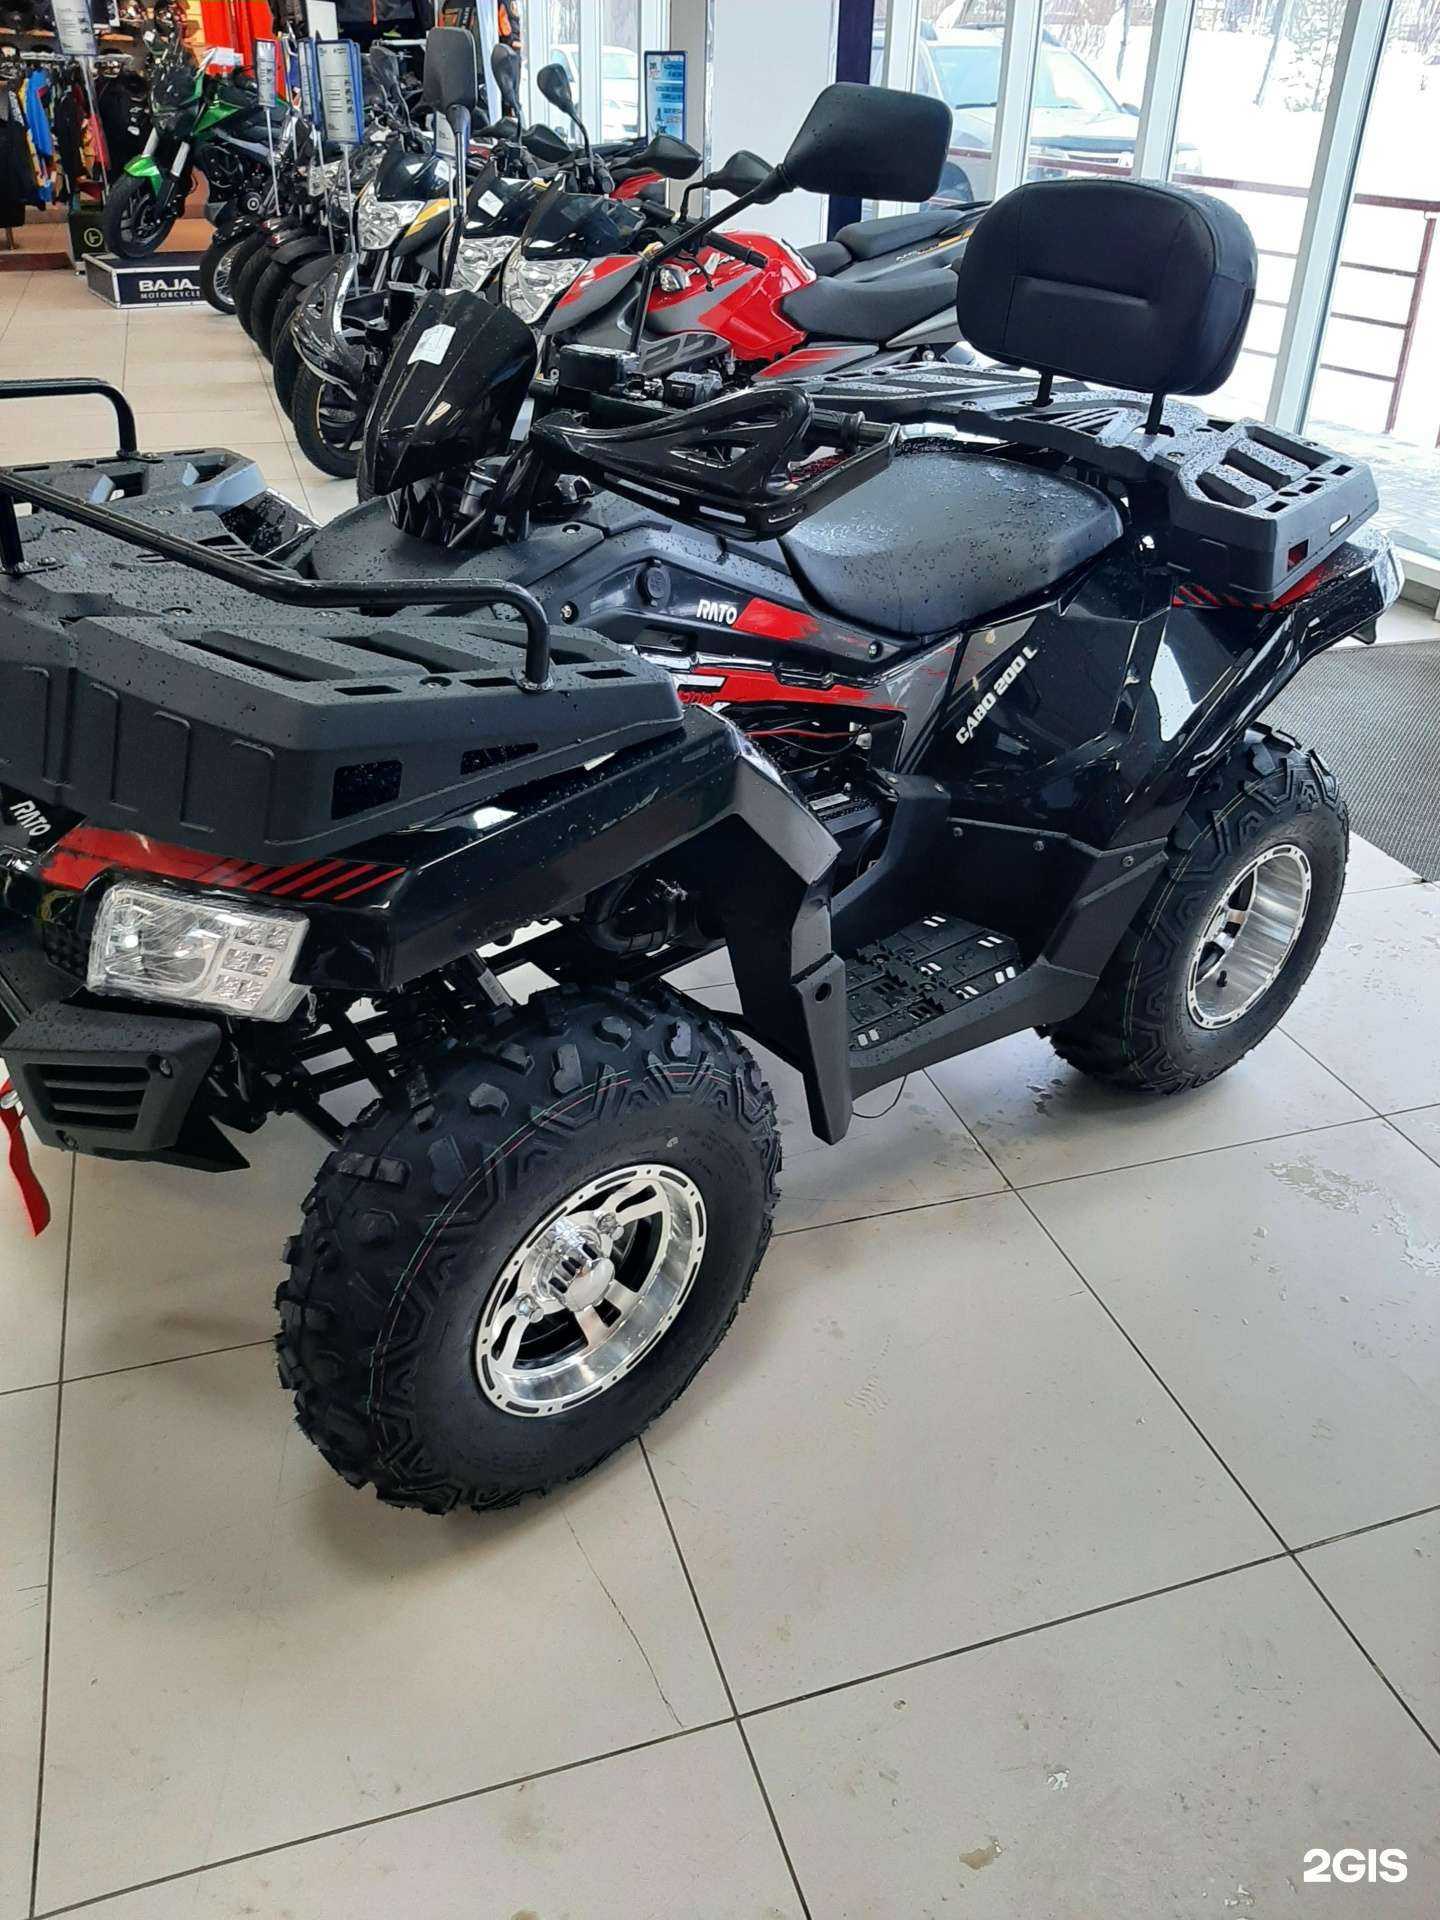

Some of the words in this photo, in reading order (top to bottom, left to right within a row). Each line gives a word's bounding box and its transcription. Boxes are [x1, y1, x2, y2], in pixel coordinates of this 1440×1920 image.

[696, 598, 738, 625] RATO
[955, 691, 997, 745] CABO
[993, 655, 1027, 696] 200
[1022, 646, 1039, 660] L
[9, 799, 52, 836] RATO
